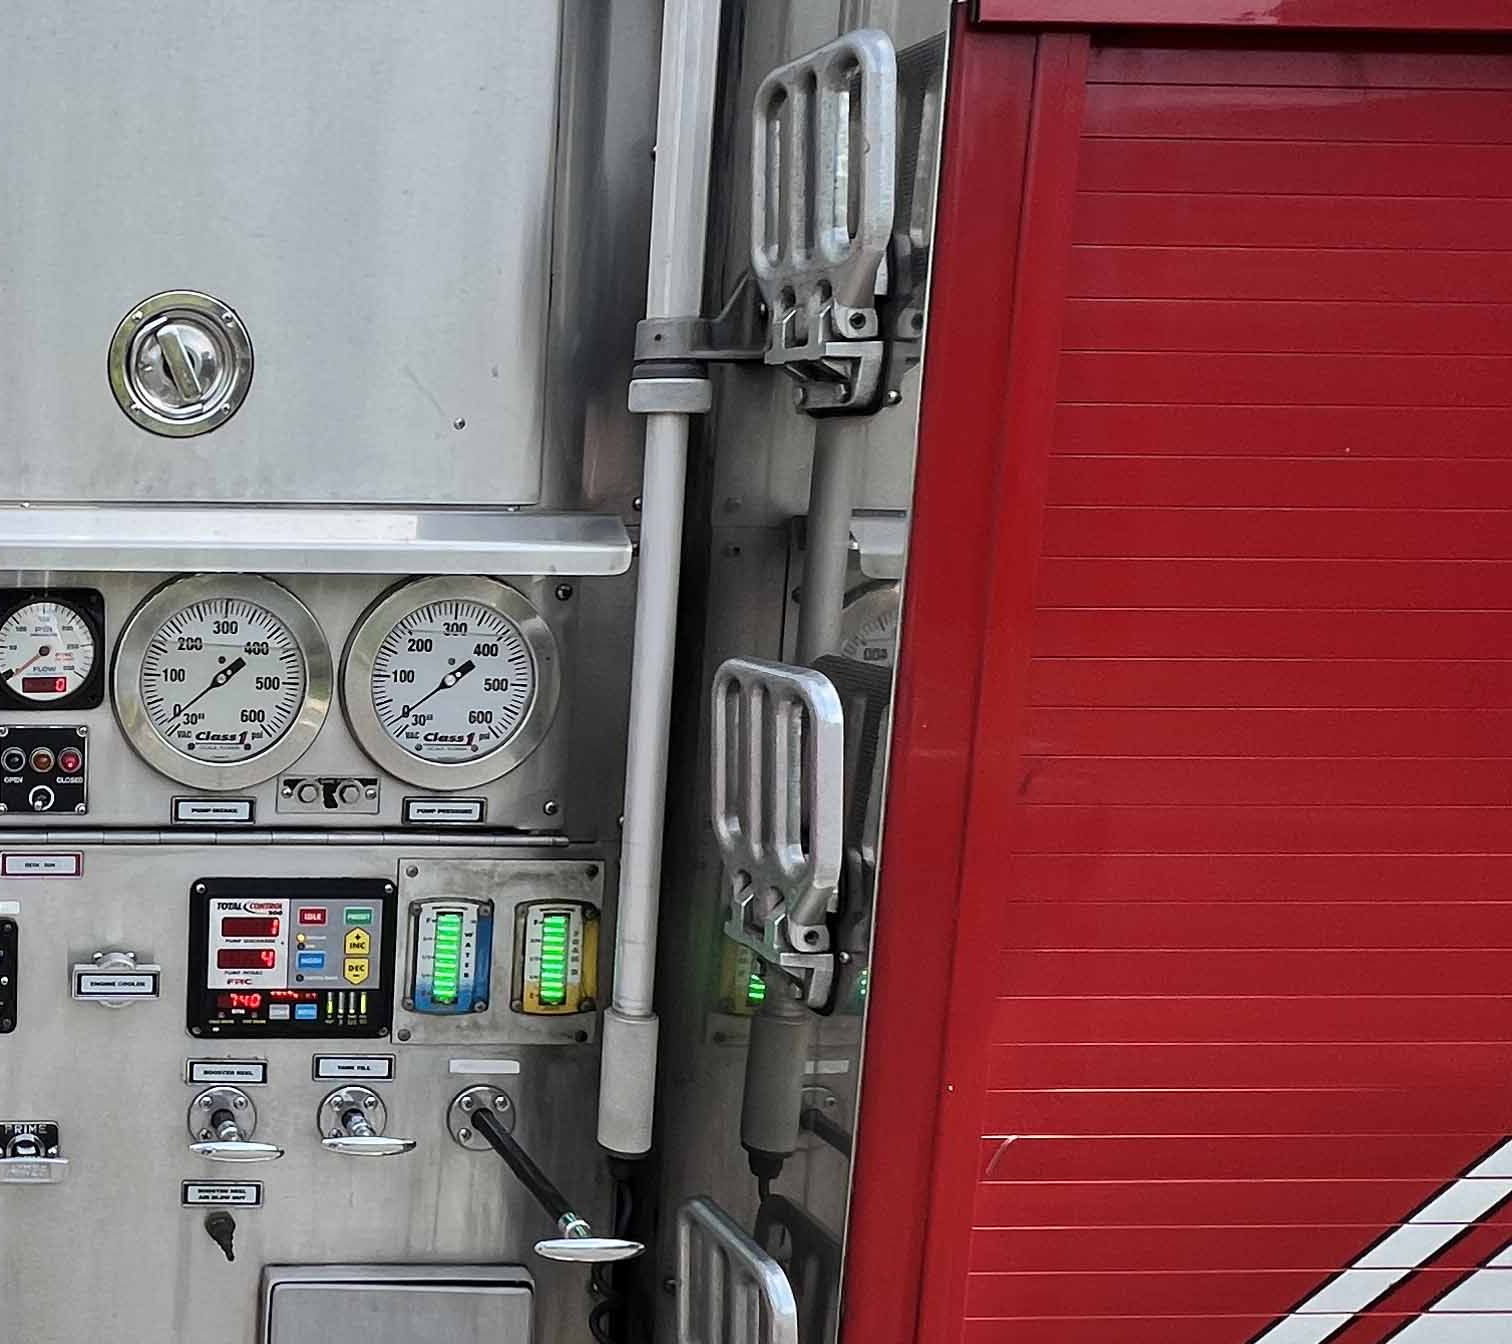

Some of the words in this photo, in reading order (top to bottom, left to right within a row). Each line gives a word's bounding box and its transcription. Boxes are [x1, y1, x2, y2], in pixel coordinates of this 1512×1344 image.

[213, 621, 238, 635] 300
[443, 623, 468, 636] 300
[178, 637, 203, 651] 200
[244, 642, 269, 655] 400
[408, 639, 433, 652] 200
[473, 644, 498, 657] 400
[162, 669, 185, 682] 100
[391, 670, 415, 683] 100
[256, 678, 280, 691] 500
[484, 679, 509, 692] 500
[173, 704, 181, 717] 0
[240, 710, 265, 723] 600
[402, 705, 410, 718] 0
[183, 712, 205, 725] 30"
[468, 711, 493, 724] 600
[217, 902, 243, 911] TOTAL
[260, 951, 274, 967] 4
[229, 993, 262, 1008] 740
[4, 1124, 47, 1134] PRIME
